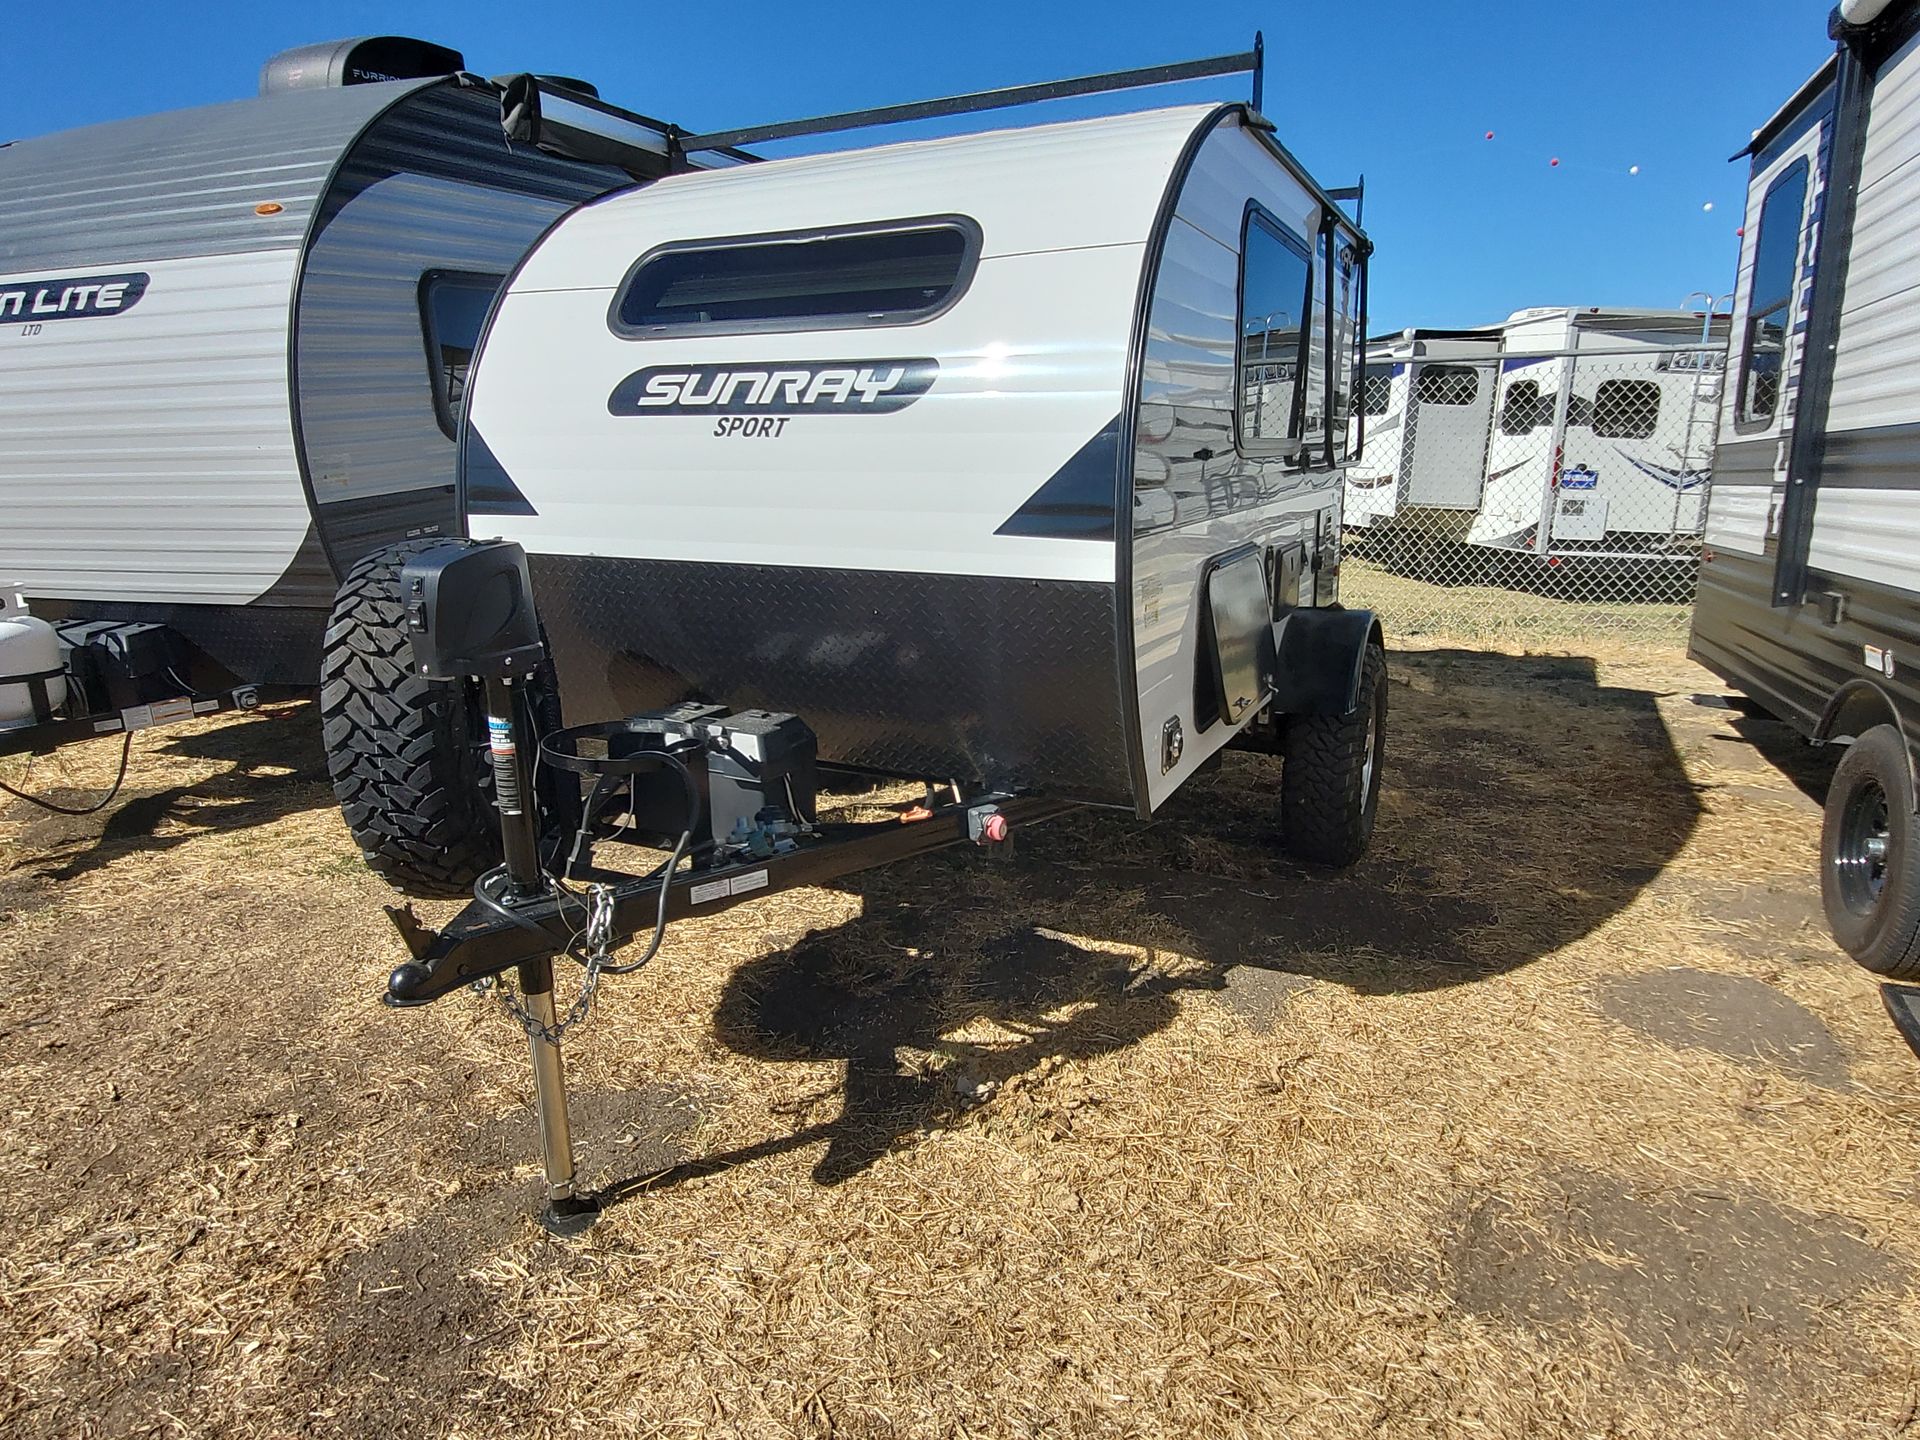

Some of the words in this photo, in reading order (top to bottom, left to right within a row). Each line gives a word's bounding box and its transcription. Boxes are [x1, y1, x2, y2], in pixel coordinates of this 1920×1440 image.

[352, 68, 401, 83] FURRIO
[31, 282, 130, 314] LITE
[21, 323, 42, 337] LTD
[637, 368, 906, 407] SUNRAY
[713, 416, 791, 439] SPORT
